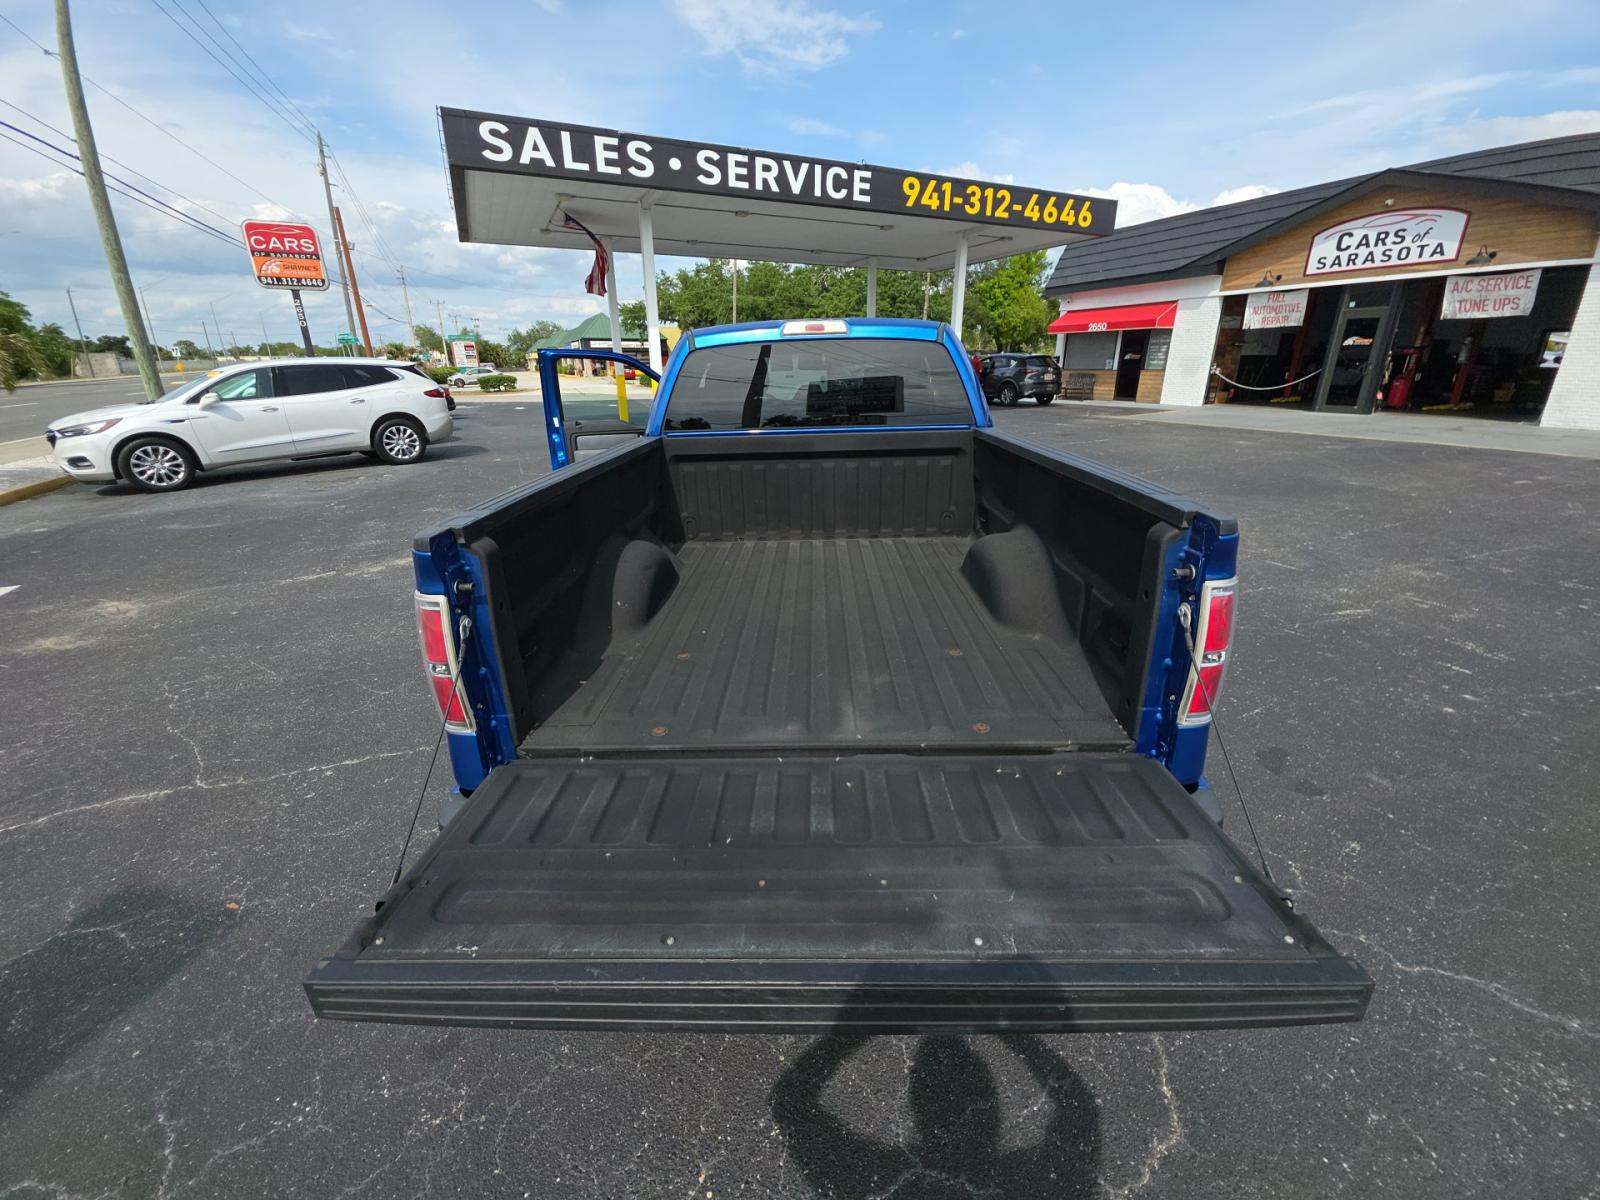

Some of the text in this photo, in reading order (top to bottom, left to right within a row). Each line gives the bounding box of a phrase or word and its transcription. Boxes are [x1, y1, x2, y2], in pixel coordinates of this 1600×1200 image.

[478, 121, 1093, 229] SALES SERVICE 941-312-4646
[250, 236, 315, 252] CARS
[1336, 227, 1434, 252] CARS of
[1316, 242, 1445, 270] SARASOTA
[260, 277, 322, 287] 941.312.4646
[1451, 274, 1534, 294] A/C SERVICE
[294, 299, 307, 327] 2650
[1251, 303, 1301, 316] AUTOMOTIVE
[1457, 297, 1520, 313] TUNE UPS
[1088, 322, 1108, 331] 2650
